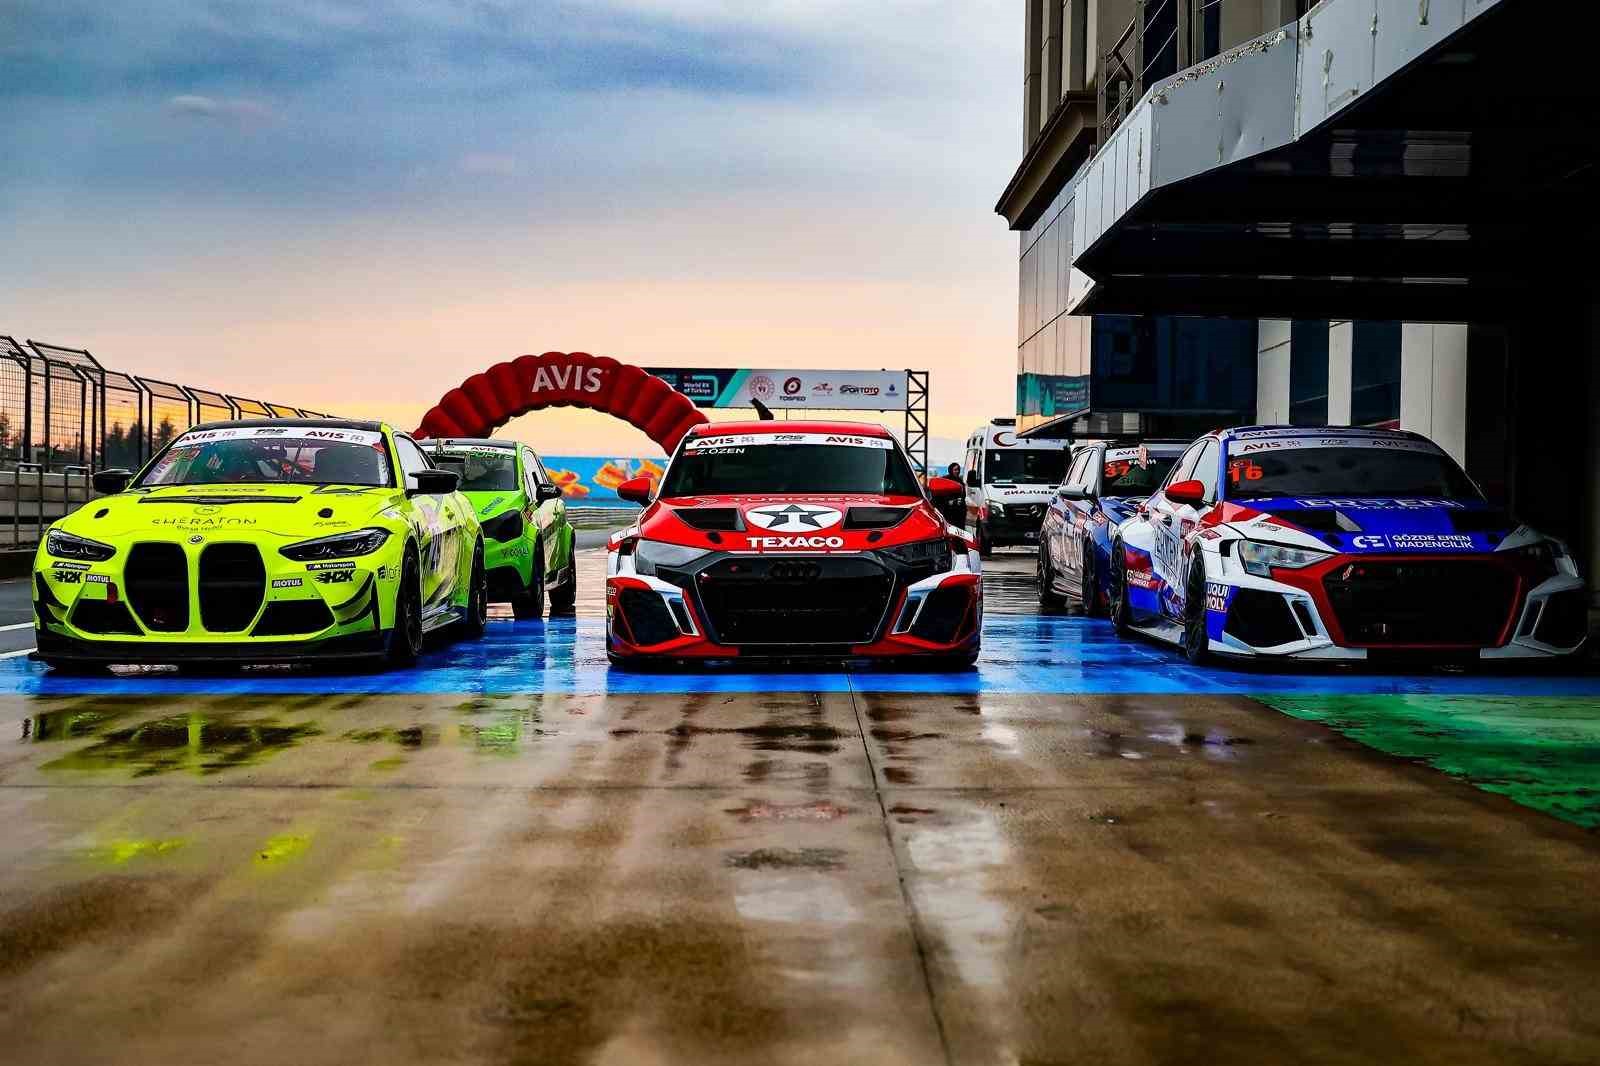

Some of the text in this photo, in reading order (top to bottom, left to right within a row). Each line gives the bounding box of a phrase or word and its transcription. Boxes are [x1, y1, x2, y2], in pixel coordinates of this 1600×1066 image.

[532, 365, 601, 393] AVIS
[178, 430, 217, 443] AVIS
[304, 430, 345, 439] AVIS
[697, 437, 735, 447] AVIS
[825, 436, 864, 445] AVIS
[1243, 441, 1281, 452] AVIS
[1104, 462, 1130, 478] 37
[1228, 465, 1264, 482] 16
[151, 516, 258, 526] SHERATON
[747, 536, 844, 548] TEXACO
[86, 575, 111, 583] MOTUL
[273, 580, 302, 588] MOTUL
